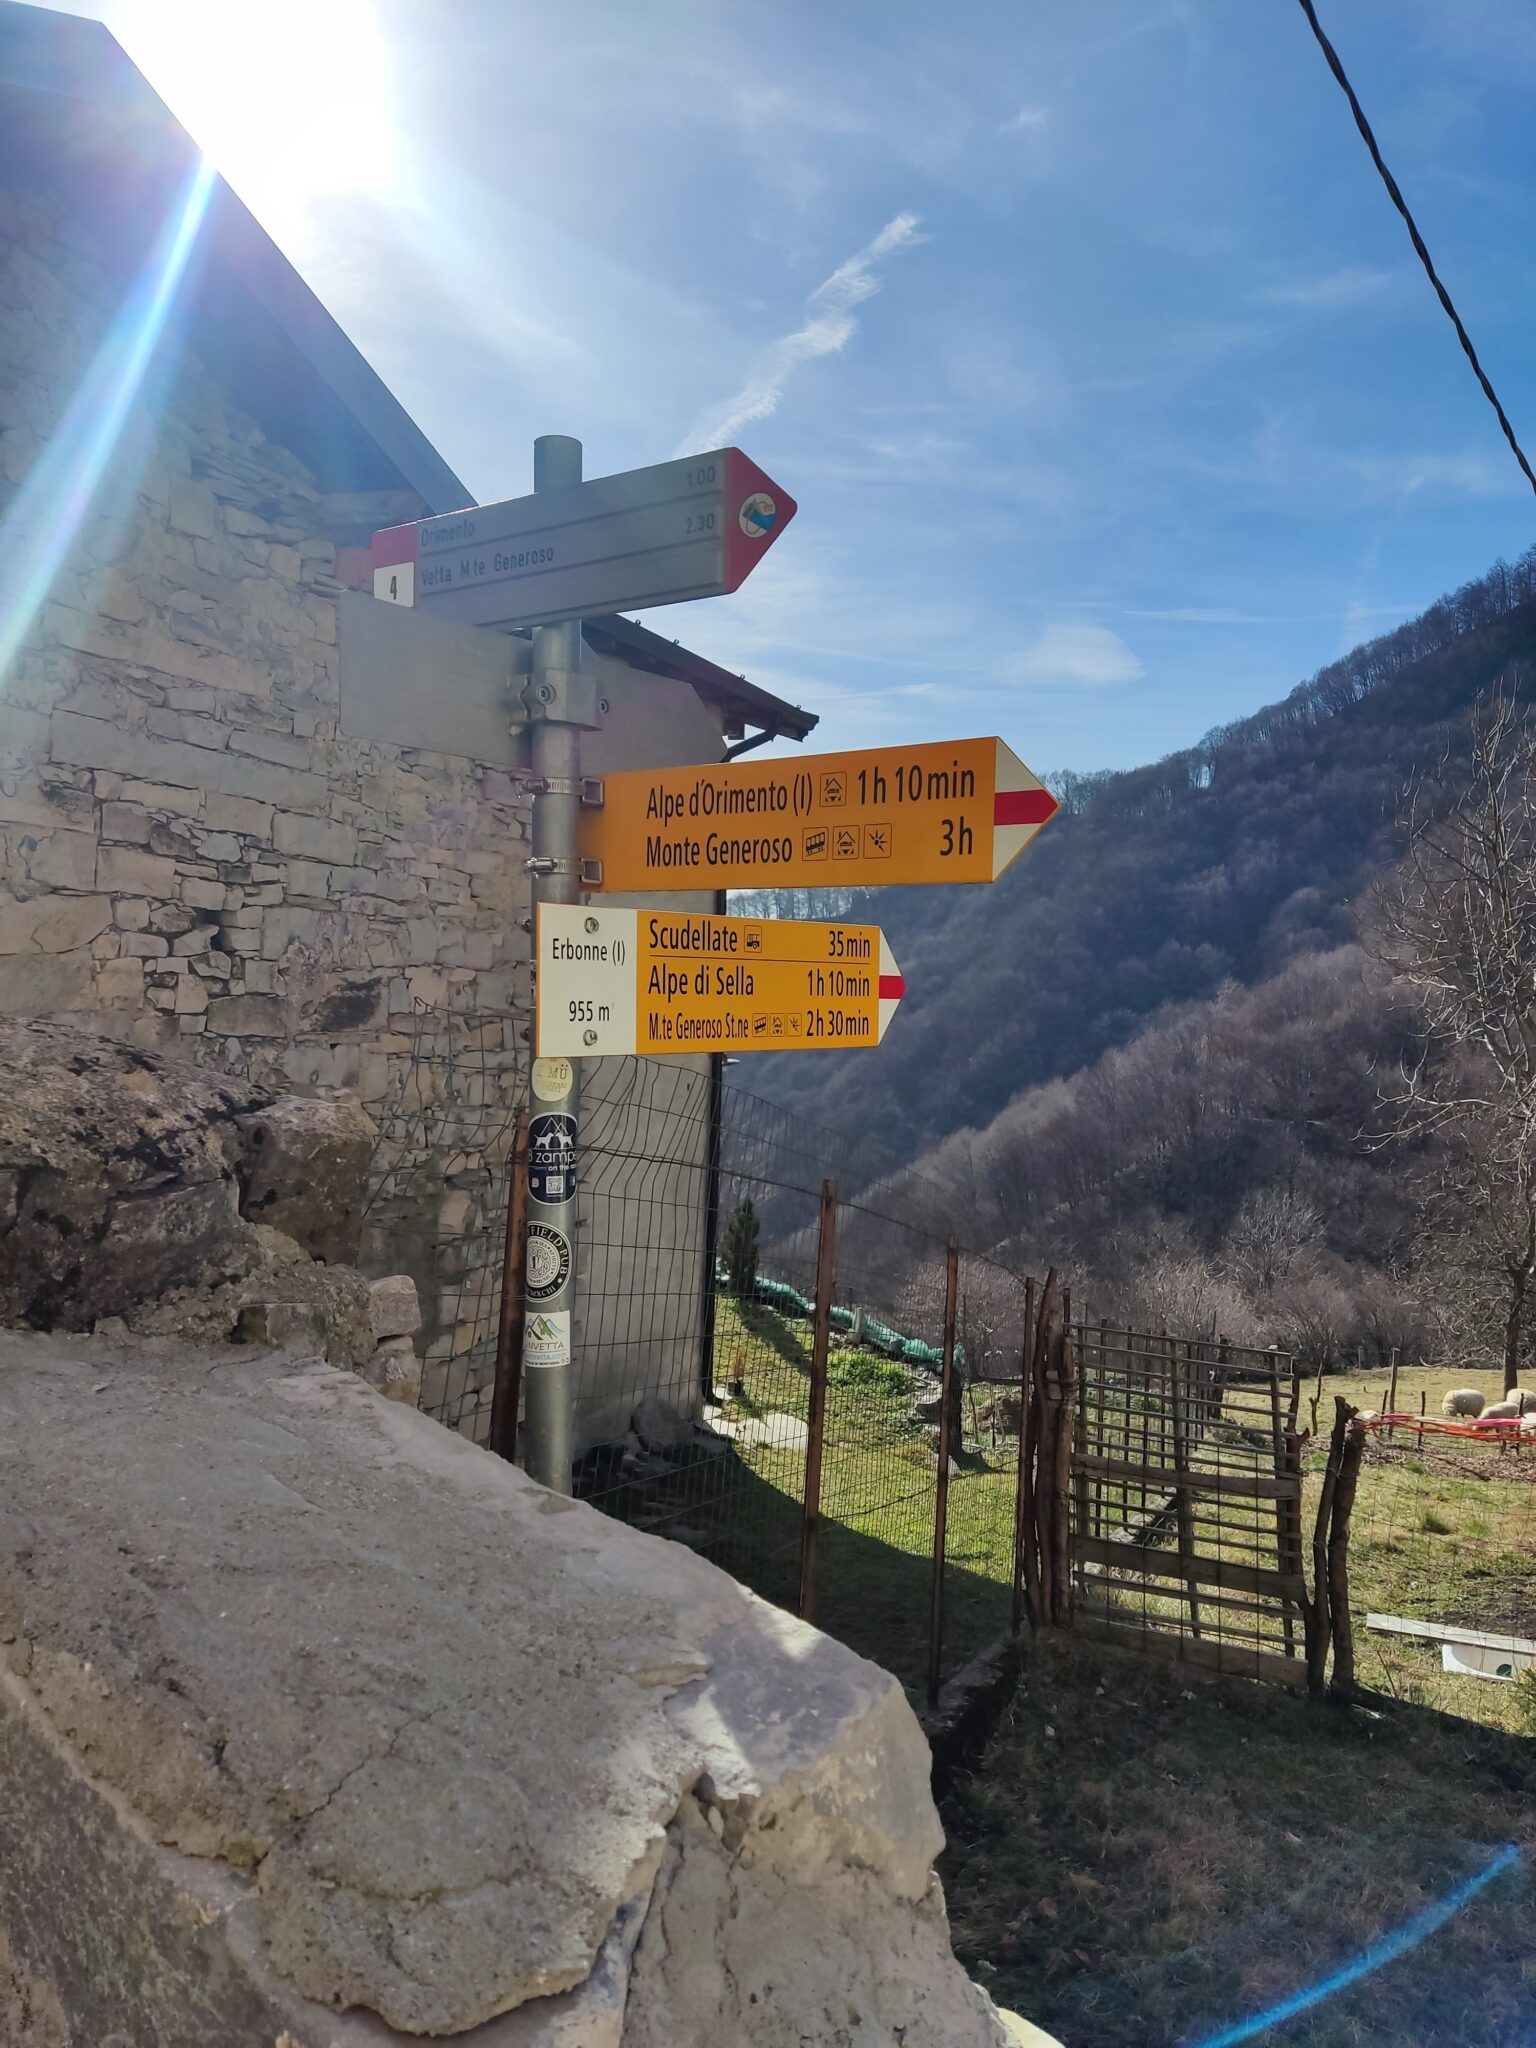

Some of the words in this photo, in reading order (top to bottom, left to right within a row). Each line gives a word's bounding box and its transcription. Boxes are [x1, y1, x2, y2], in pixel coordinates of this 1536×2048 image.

[687, 465, 716, 487] 1.00
[421, 519, 475, 547] Orimento
[686, 513, 716, 535] 2.30
[421, 567, 451, 587] Vetta
[494, 547, 554, 573] Generoso
[390, 575, 398, 600] 4
[646, 785, 684, 827] Alpe
[793, 772, 813, 816] (I)
[646, 834, 700, 867] Monte
[706, 832, 793, 866] Generoso
[939, 816, 974, 856] 3h
[649, 918, 738, 952] Scudellate
[552, 937, 608, 961] Erbonne
[612, 939, 626, 966] (I)
[648, 963, 688, 1003] Alpe
[694, 964, 710, 995] di
[716, 965, 754, 996] Sella
[569, 1000, 594, 1022] 955
[598, 1004, 610, 1022] m
[649, 1012, 673, 1040] M.te
[676, 1012, 722, 1040] Generoso
[725, 1012, 749, 1039] St.ne
[528, 1226, 563, 1247] FIELD
[559, 1248, 569, 1274] PUB
[528, 1285, 556, 1297] MXCIII
[528, 1341, 564, 1350] NVETTA
